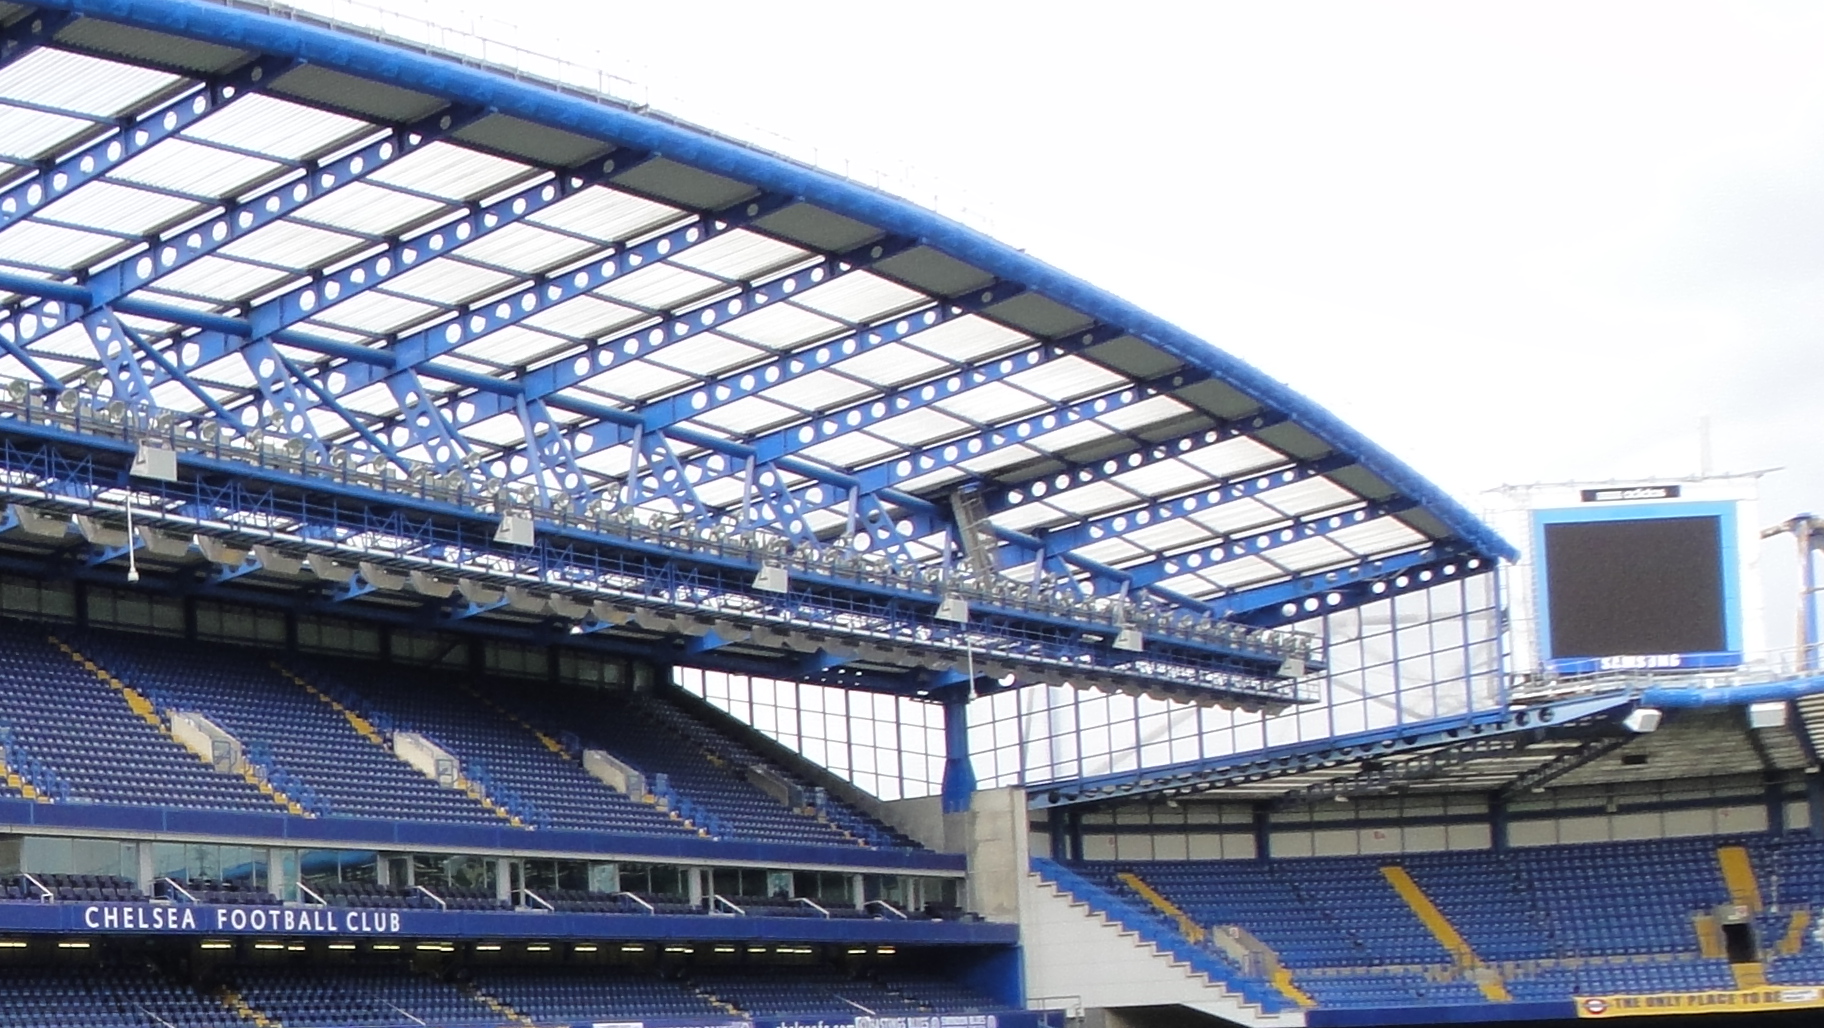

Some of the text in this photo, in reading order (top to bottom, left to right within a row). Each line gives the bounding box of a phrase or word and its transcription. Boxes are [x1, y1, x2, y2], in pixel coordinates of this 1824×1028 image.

[84, 906, 400, 932] CHELSEA FOOTBALL CLUB
